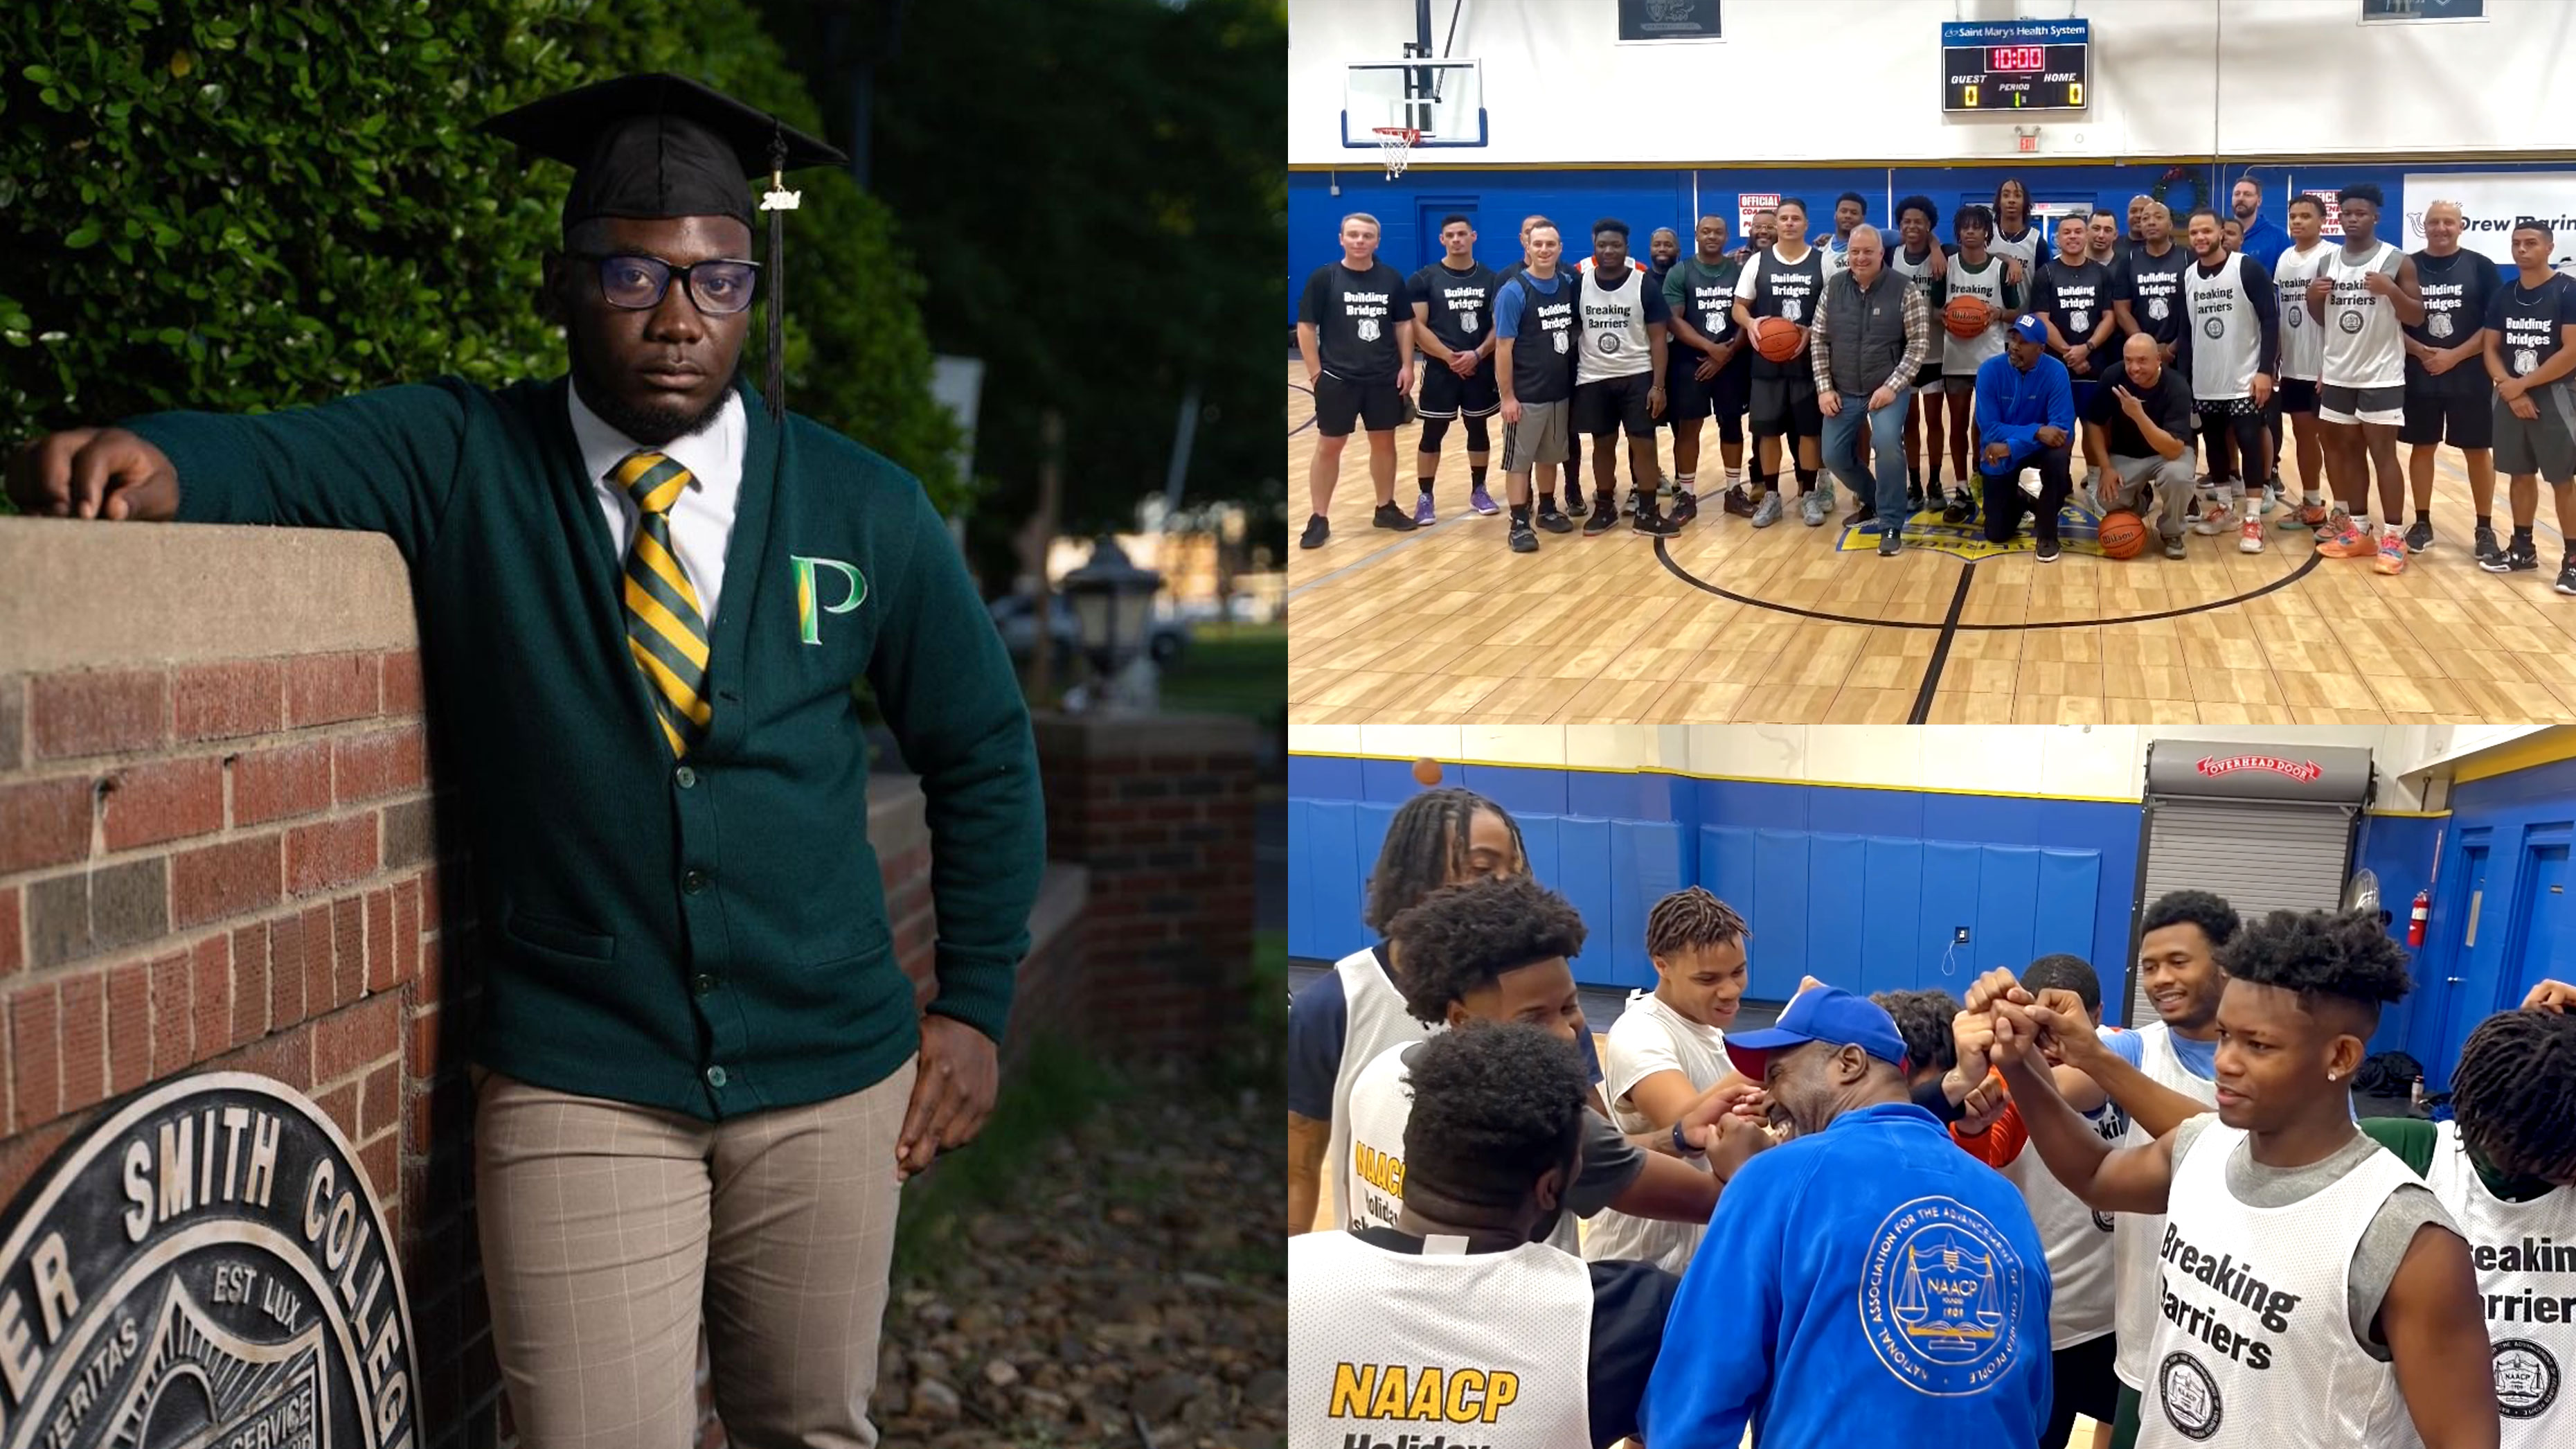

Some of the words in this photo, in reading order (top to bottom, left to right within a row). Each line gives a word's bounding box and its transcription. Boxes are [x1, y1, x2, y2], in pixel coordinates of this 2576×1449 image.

[1959, 28, 1983, 37] Saint
[1985, 28, 2014, 38] Mary's
[2016, 26, 2048, 35] Health
[2051, 25, 2085, 35] System
[1994, 48, 2041, 69] 10:00
[1951, 75, 1987, 84] GUEST
[2044, 73, 2076, 82] HOME
[1999, 83, 2030, 91] PERIOD
[2070, 83, 2082, 104] 0
[1965, 85, 1977, 106] 0
[1741, 195, 1779, 206] OFFICIAL
[2462, 217, 2511, 231] Drew
[1771, 274, 1812, 285] Building
[2137, 272, 2178, 283] Building
[1444, 287, 1485, 298] Building
[1696, 286, 1733, 297] Building
[1772, 285, 1810, 297] Bridges
[1950, 283, 1993, 297] Breaking
[2057, 285, 2095, 296] Building
[2139, 285, 2176, 296] Bridges
[1343, 292, 1388, 305] Building
[1448, 299, 1483, 310] Bridges
[1698, 299, 1733, 310] Bridges
[2059, 299, 2094, 309] Bridges
[2330, 294, 2376, 305] Barriers
[2424, 299, 2462, 311] ridges
[1346, 305, 1387, 317] Bridges
[1537, 303, 1571, 317] Building
[1585, 304, 1631, 317] Breaking
[2198, 302, 2233, 314] arriers
[1541, 317, 1572, 330] Bridges
[1589, 319, 1629, 328] Barriers
[2506, 317, 2552, 332] Building
[2507, 333, 2550, 347] Bridges
[2102, 531, 2134, 545] Wilson
[790, 554, 868, 646] P
[2210, 758, 2274, 774] OVERHEAD
[2277, 761, 2307, 780] DOOR
[1917, 1207, 1939, 1220] THE
[1895, 1214, 1917, 1235] FOR
[1943, 1207, 2015, 1264] ADVANCEMENT
[0, 1231, 80, 1407] ER
[123, 1107, 281, 1243] SMITH
[2470, 1237, 2576, 1272] eakin
[1868, 1231, 1897, 1322] ASSOCIATION
[2161, 1222, 2302, 1333] Breaking
[1928, 1277, 1978, 1297] NAACP
[214, 1265, 257, 1305] EST
[264, 1276, 303, 1332] LUX
[1877, 1326, 1929, 1381] NATIONAL
[1969, 1354, 2007, 1384] PEOPLE
[1328, 1362, 1519, 1423] NAACP
